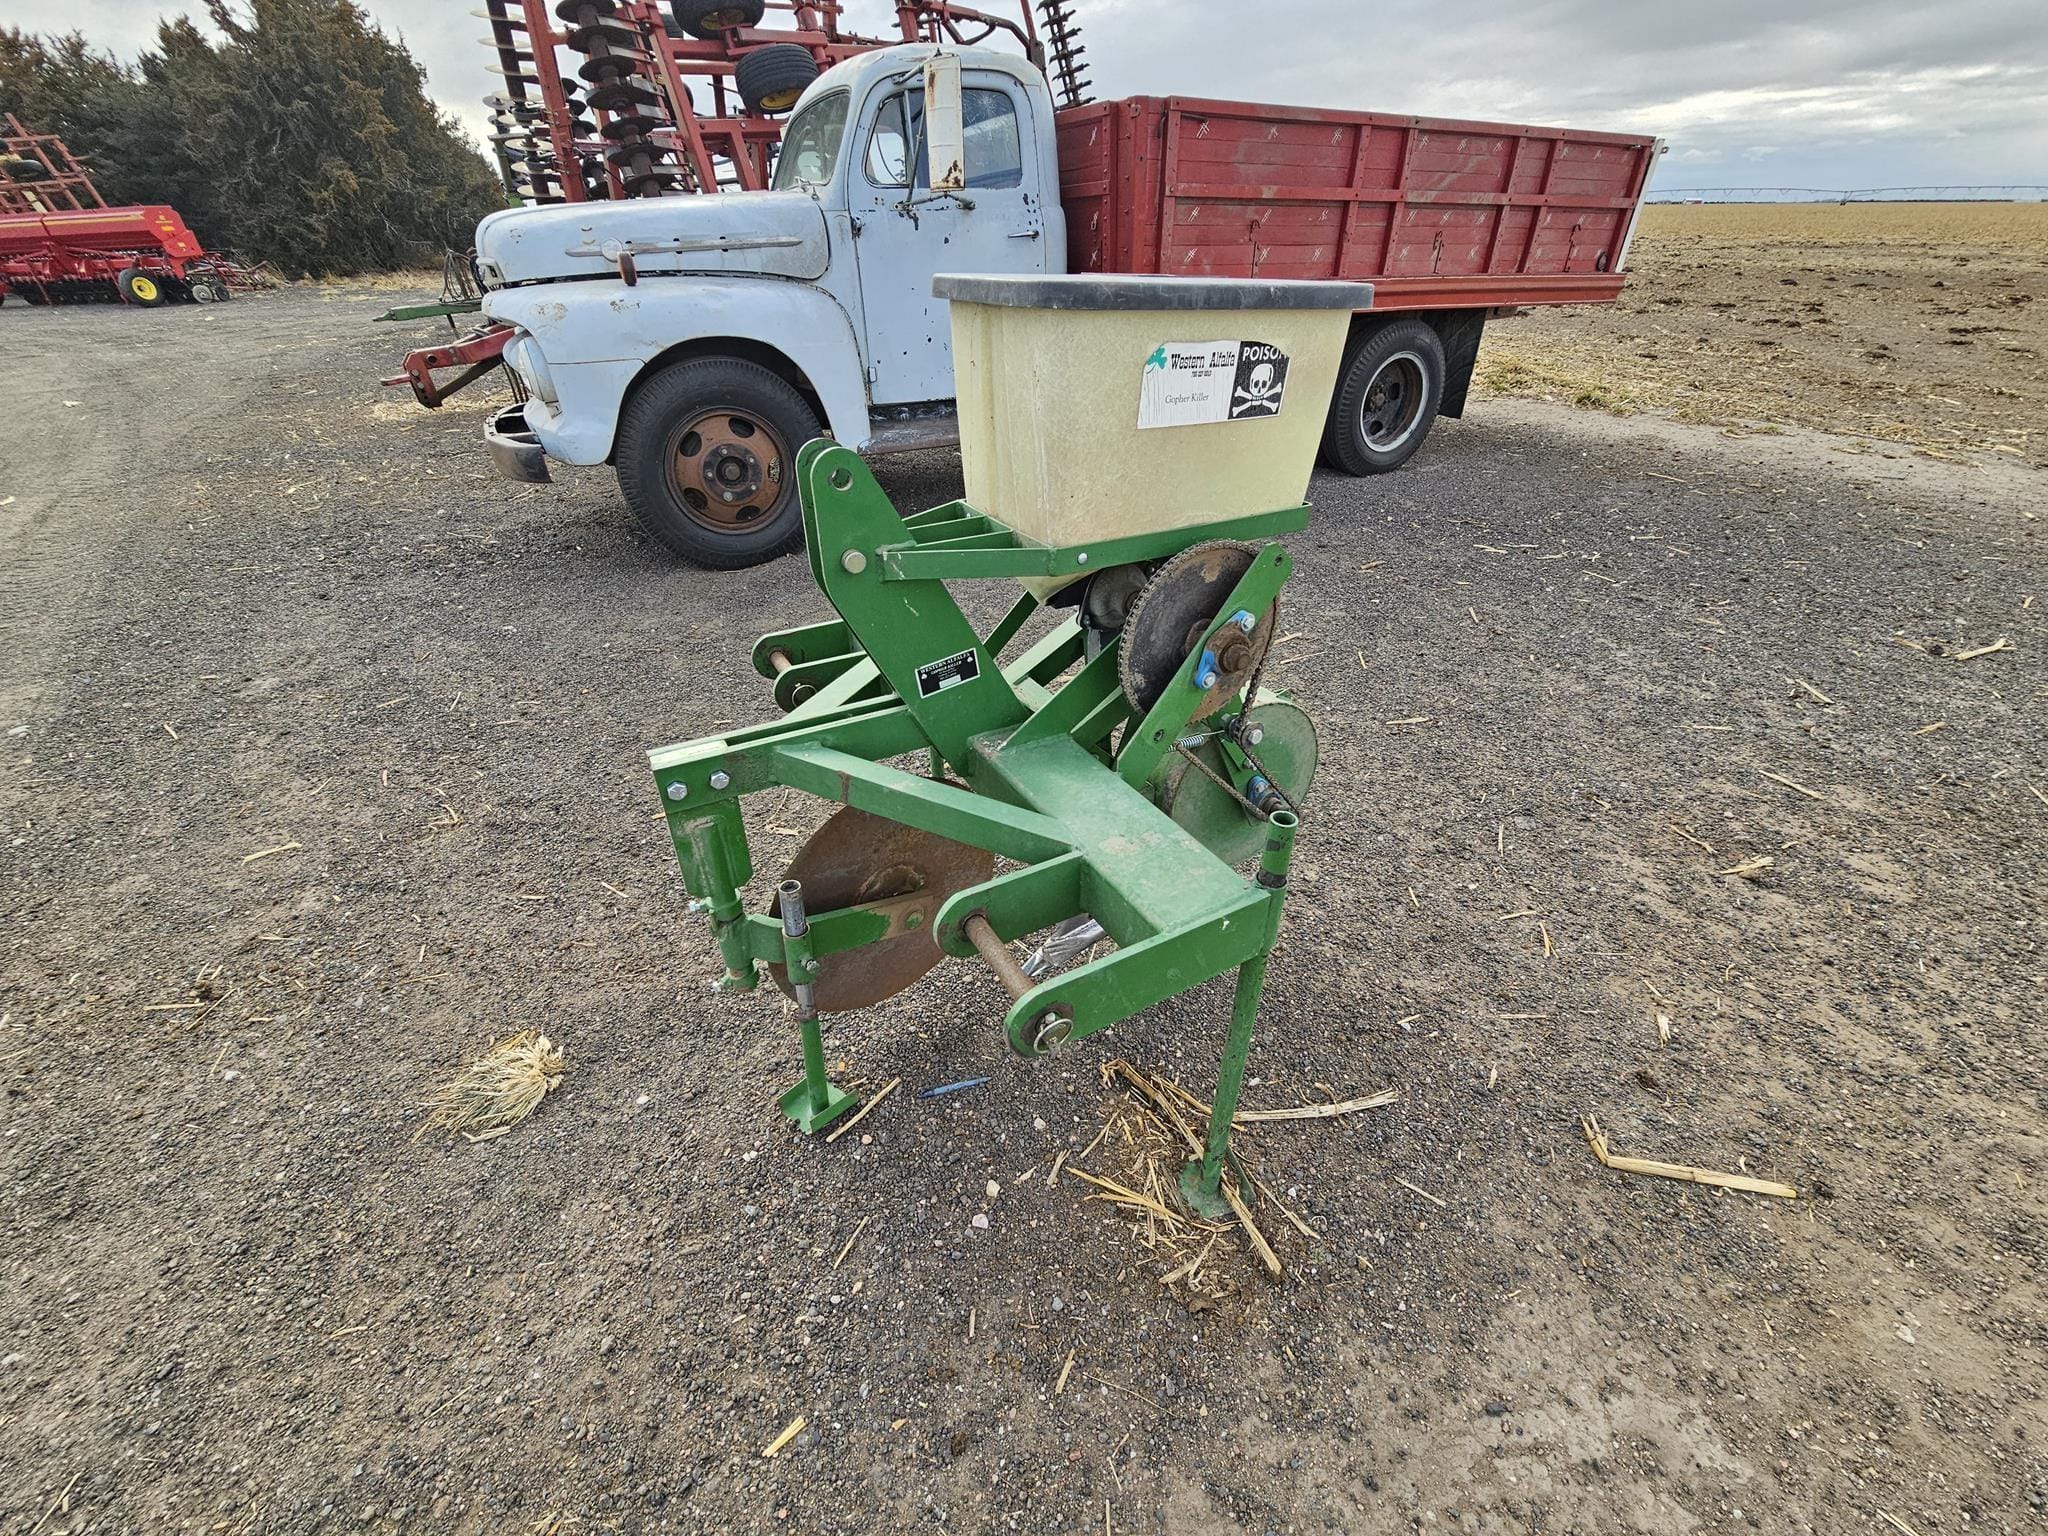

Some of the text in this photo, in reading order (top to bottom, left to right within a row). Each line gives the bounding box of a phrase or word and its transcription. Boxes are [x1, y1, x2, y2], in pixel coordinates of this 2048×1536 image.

[1171, 351, 1235, 370] Western Alfalfa
[1165, 392, 1209, 405] Gopher Killer
[920, 661, 946, 674] WESTERN
[946, 653, 970, 664] ALFALFA
